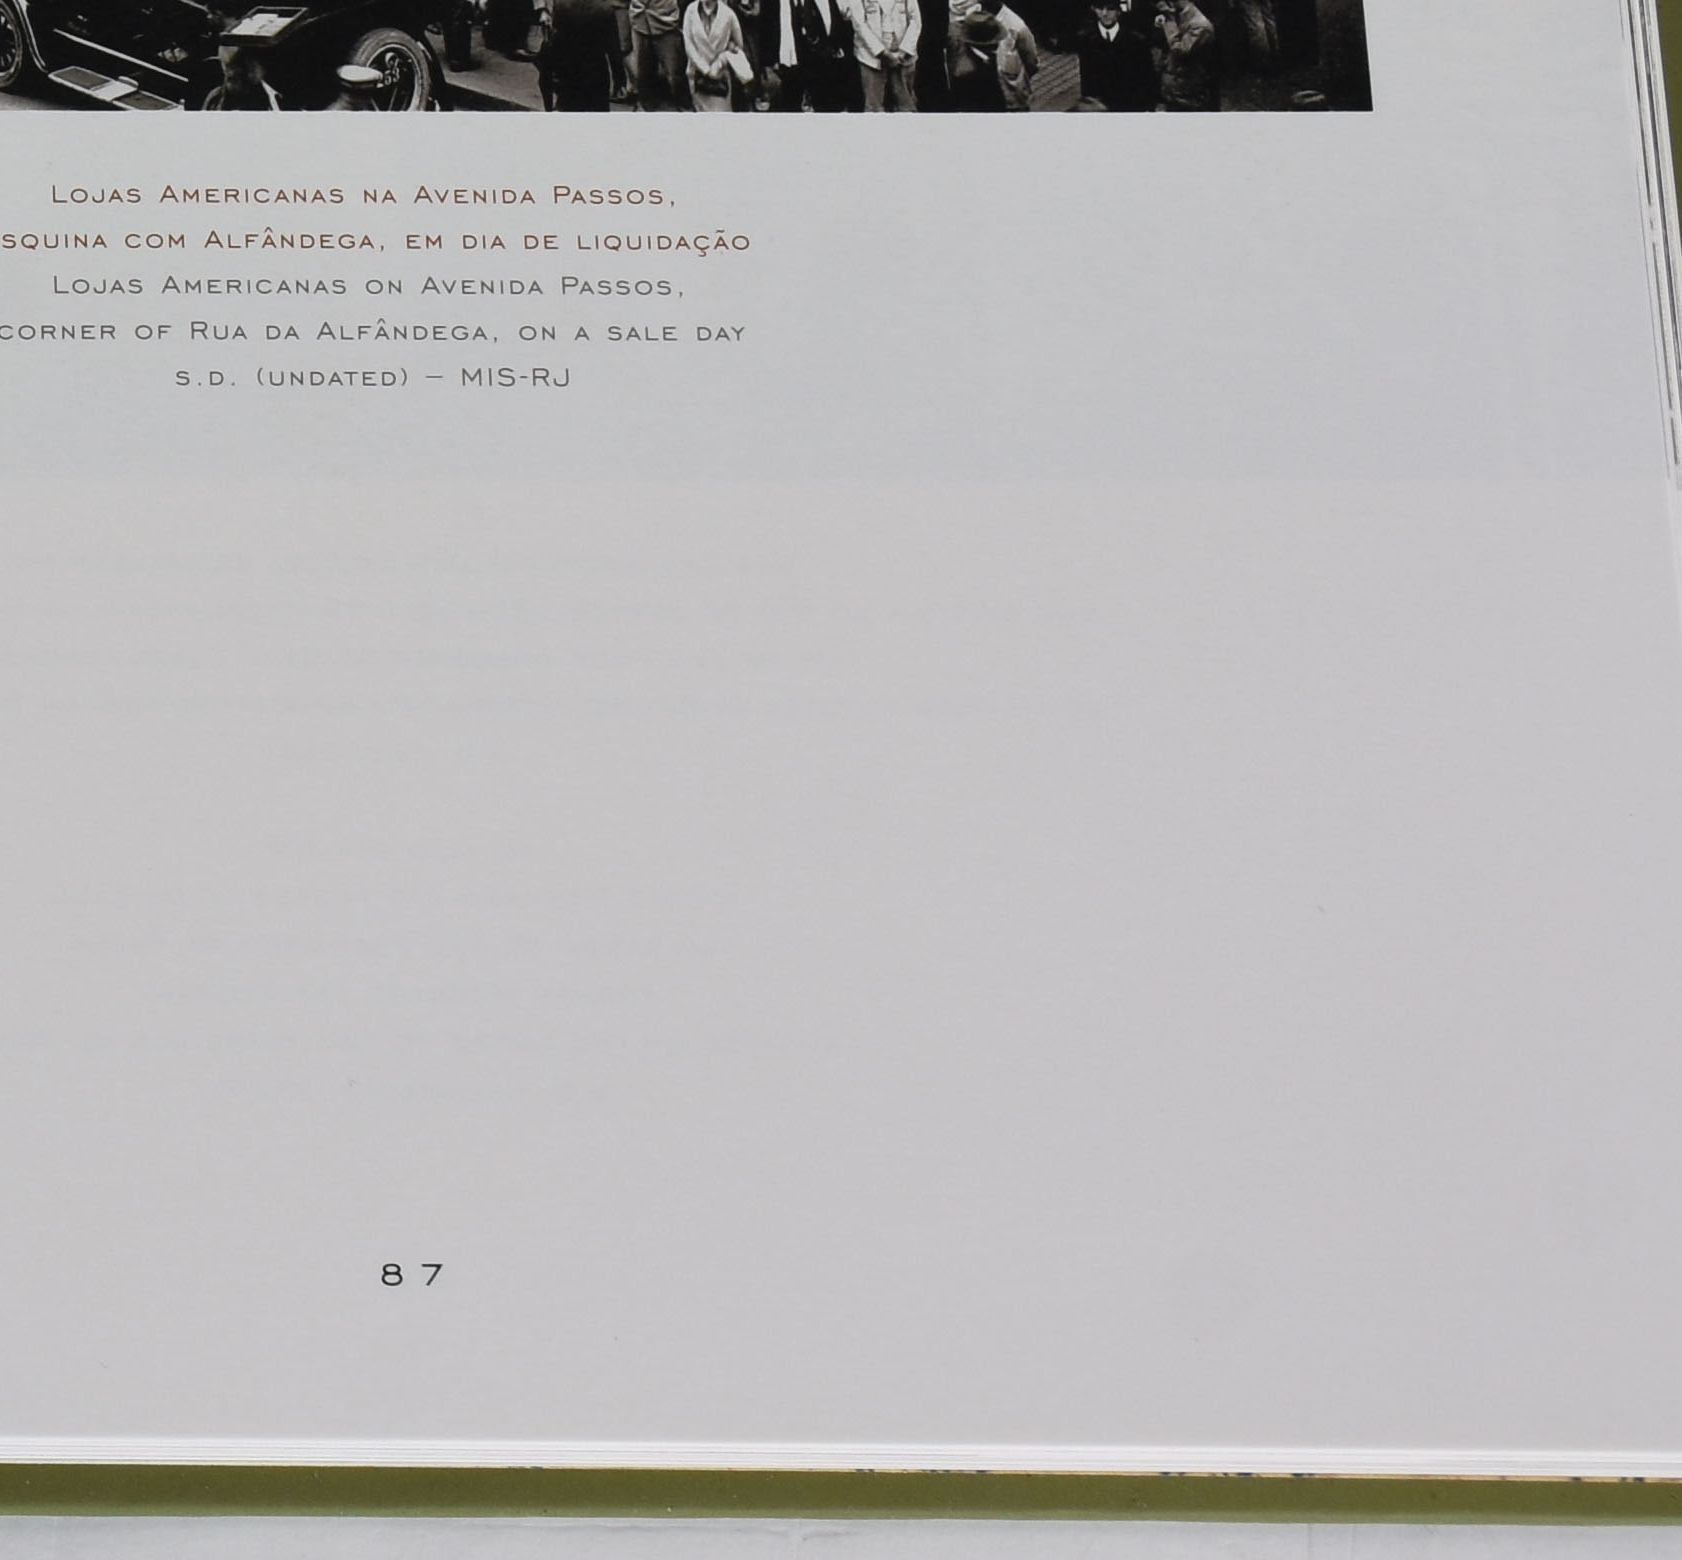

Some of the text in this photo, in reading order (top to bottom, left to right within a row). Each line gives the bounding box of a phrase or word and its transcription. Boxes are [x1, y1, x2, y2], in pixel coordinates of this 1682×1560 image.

[51, 184, 675, 208] LOJAS AMERICANAS NA AVENIDA PASSOS,
[124, 233, 186, 249] COM
[203, 226, 385, 252] ALFÂNDEGA,
[405, 234, 443, 250] EM
[462, 234, 507, 250] DIA
[523, 234, 560, 250] DE
[577, 229, 750, 258] LIQUIDAÇÃO
[53, 275, 684, 299] LOJAS AMERICANAS ON AVENIDA PASSOS,
[134, 324, 173, 341] OF
[190, 320, 248, 341] RUA
[265, 324, 300, 341] DA
[316, 317, 498, 344] ALFÂNDEGA,
[518, 325, 556, 342] ON
[574, 325, 590, 342] A
[607, 325, 679, 342] SALE
[696, 326, 746, 342] DAY
[175, 367, 570, 388] S.D. (UNDATED) MIS-RJ
[380, 1262, 444, 1287] 87
